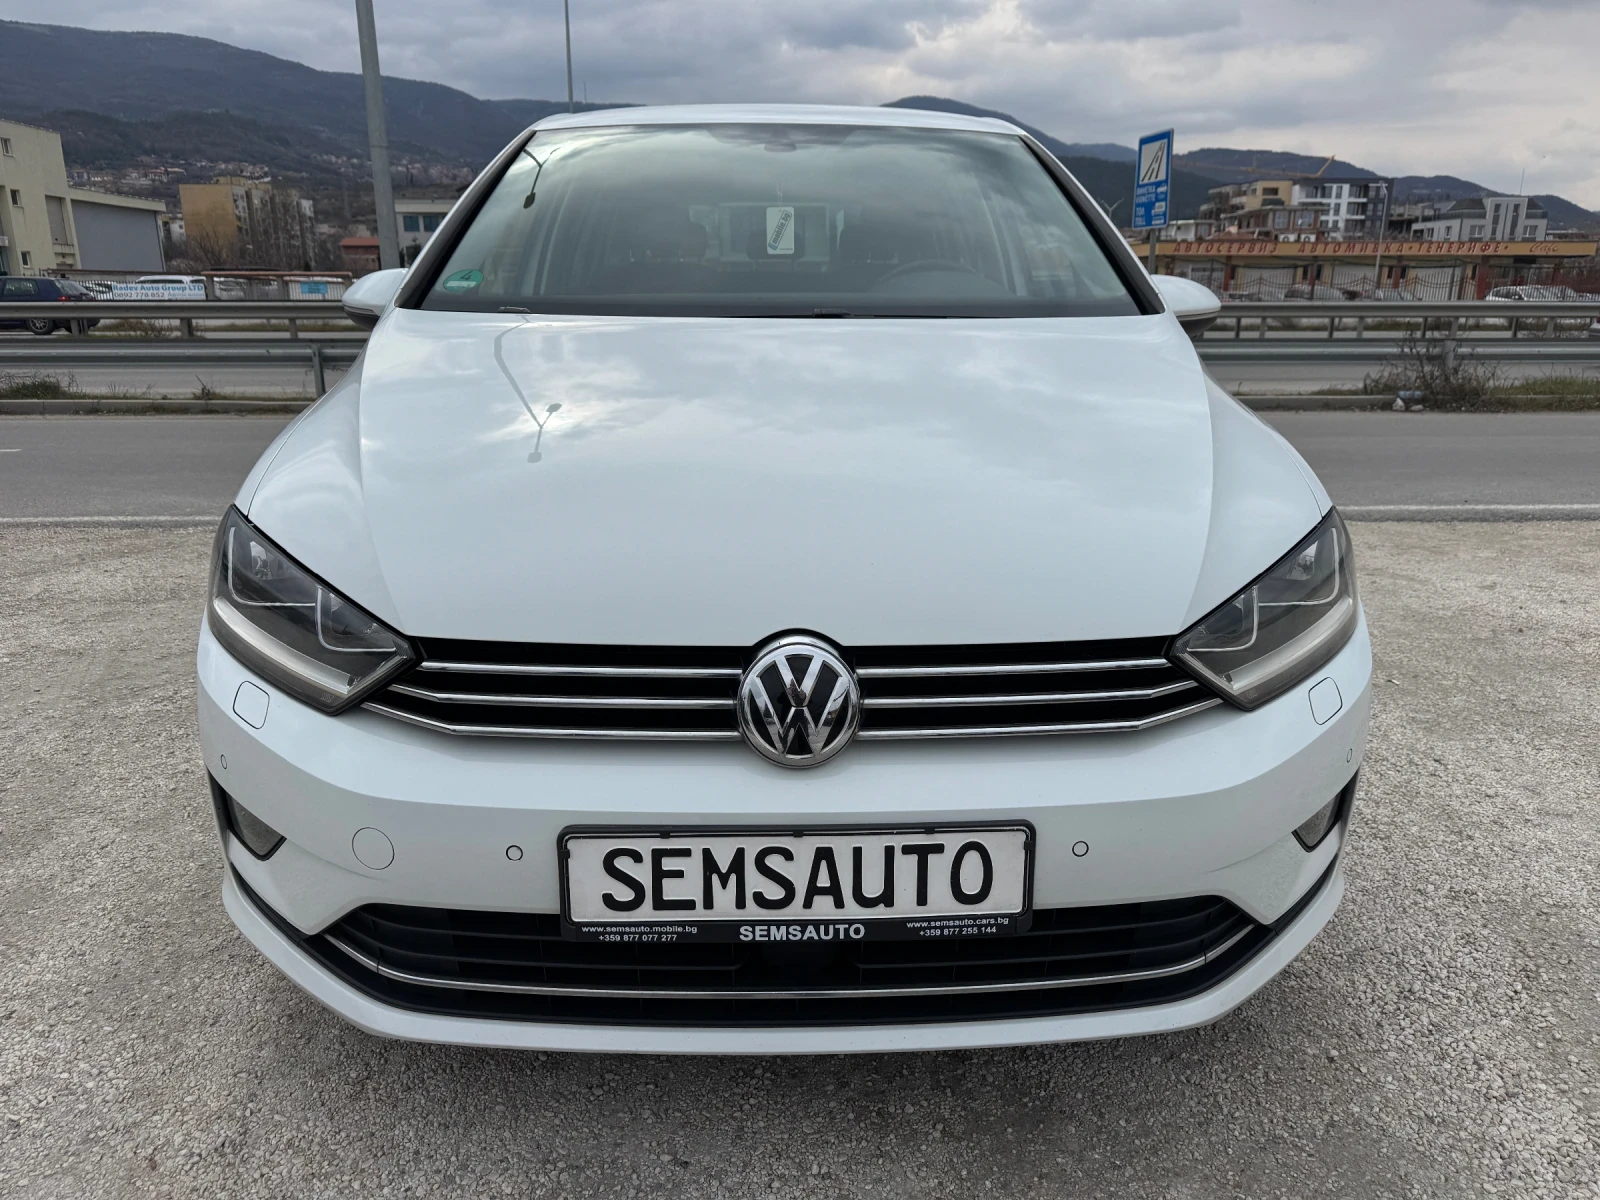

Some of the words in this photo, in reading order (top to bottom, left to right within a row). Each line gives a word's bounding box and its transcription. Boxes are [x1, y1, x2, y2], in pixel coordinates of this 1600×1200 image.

[772, 212, 792, 244] mobile.bg
[1173, 242, 1278, 253] АВТОСЕРВИЗ
[1298, 242, 1404, 253] АВТОМИВКА
[1417, 241, 1501, 253] ТЕНЕРИФЕ
[460, 270, 473, 281] 4
[112, 284, 138, 292] Radev
[140, 284, 160, 292] Auto
[161, 284, 187, 293] Group
[188, 283, 204, 291] LTD
[601, 840, 994, 912] SEMSAUTO
[906, 916, 1009, 928] www.semsauto.cars.bg
[581, 925, 698, 934] www.semsauto.mobile.bg
[739, 923, 866, 941] SEMSAUTO
[919, 928, 941, 937] +359
[943, 928, 960, 936] 877
[962, 926, 978, 935] 255
[981, 926, 997, 934] 144
